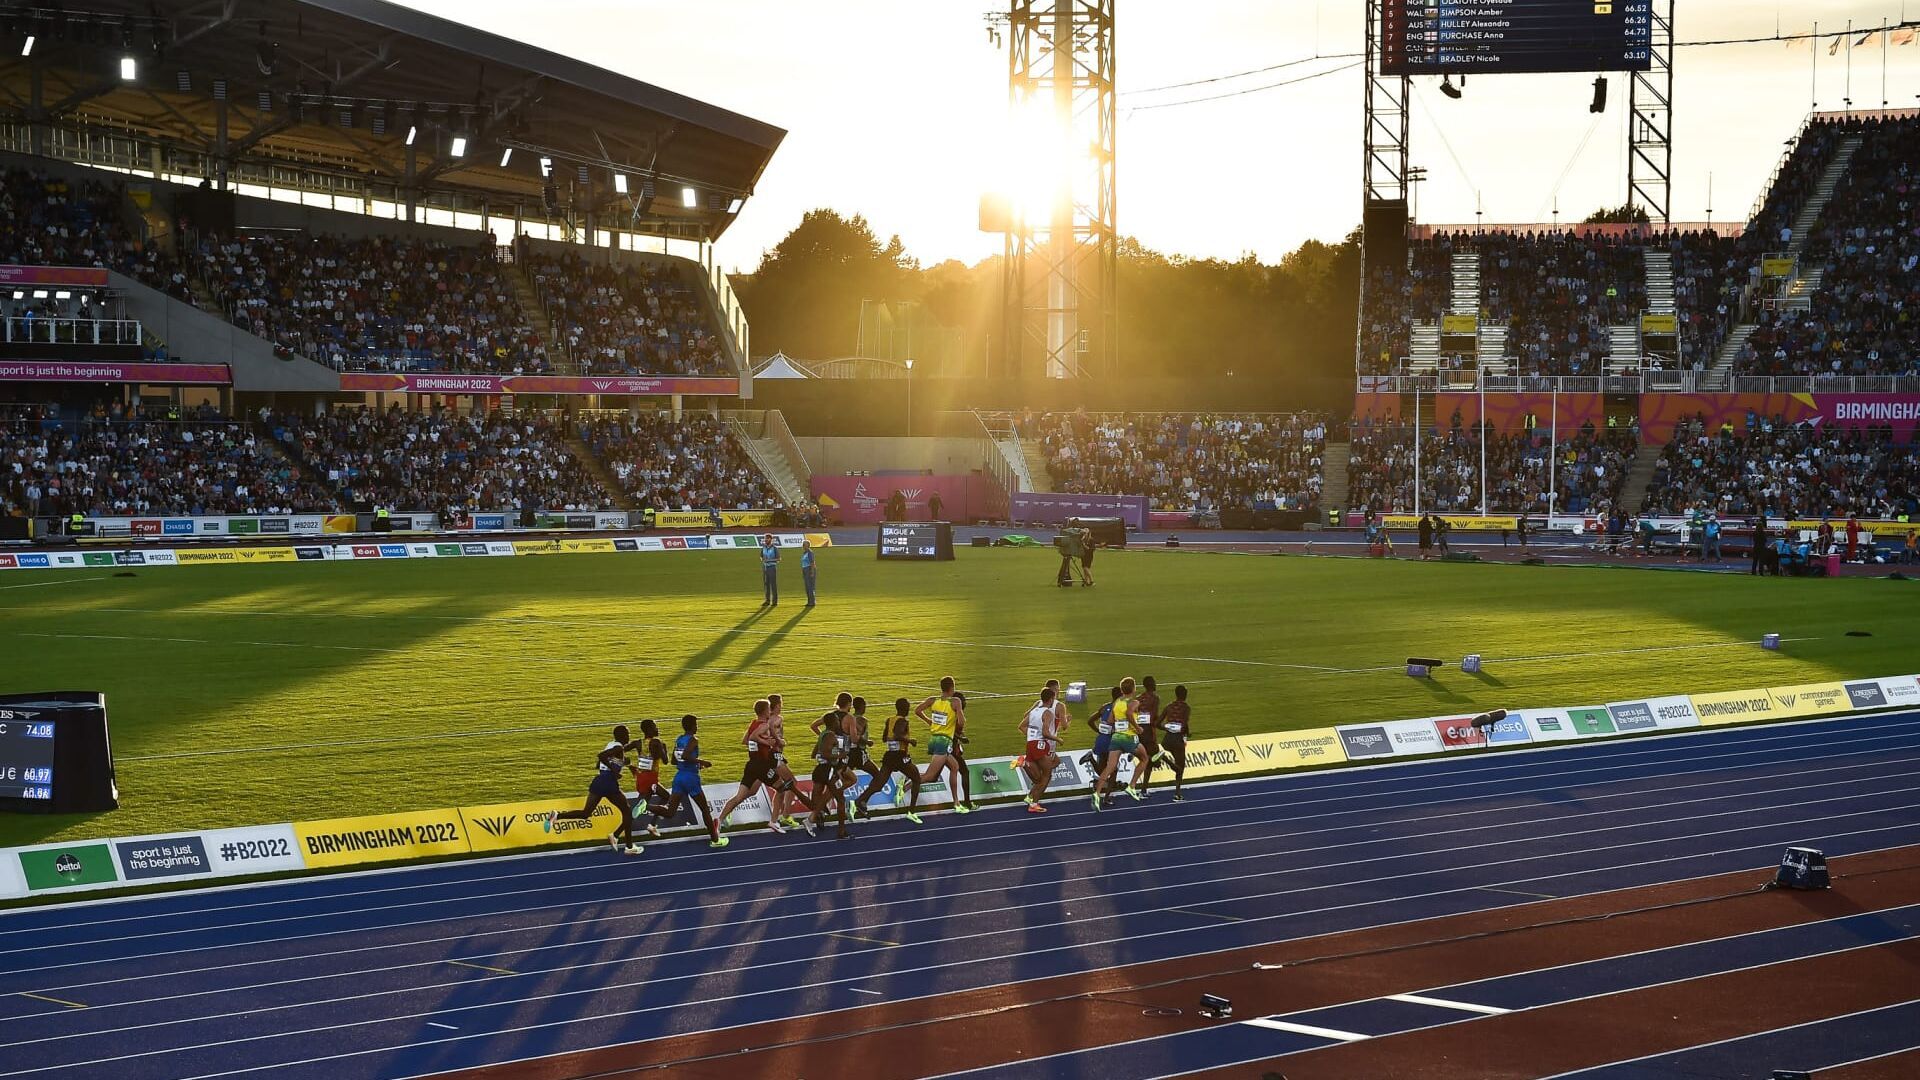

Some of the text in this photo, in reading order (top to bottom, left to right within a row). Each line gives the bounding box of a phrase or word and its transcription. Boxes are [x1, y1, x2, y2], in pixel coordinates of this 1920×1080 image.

[1406, 9, 1424, 17] WAL
[1441, 8, 1476, 16] SIMPSON
[1624, 4, 1647, 12] 66.52
[1408, 21, 1424, 29] AUS
[1440, 20, 1470, 28] HULLEY
[1470, 20, 1510, 28] Alexandra
[1624, 16, 1647, 24] 66.26
[1388, 33, 1393, 41] 7
[1406, 32, 1424, 40] ENG
[1440, 32, 1482, 40] PURCHASE
[1624, 28, 1646, 36] 64.73
[1407, 56, 1423, 64] NZL
[1440, 55, 1476, 63] BRADLEY
[1476, 54, 1500, 62] Nicole
[1623, 51, 1646, 59] 63.10
[0, 365, 122, 378] sport is just the beginning
[416, 378, 492, 390] BIRMINGHAM 2022
[662, 516, 703, 525] BIRMINGHAM
[883, 528, 908, 536] HAGUE
[883, 537, 898, 545] ENG
[178, 553, 219, 561] BIRMINGHAM
[1657, 704, 1693, 720] #B2022
[1696, 698, 1772, 717] BIRMINGHAM 2022
[26, 724, 52, 736] 74.08
[1278, 736, 1337, 751] commonwealth
[1348, 734, 1384, 744] LONGINES
[1209, 748, 1241, 766] 2022
[1297, 746, 1325, 760] games
[552, 819, 593, 835] games
[305, 822, 460, 855] BIRMINGHAM 2022
[131, 844, 193, 860] sport is just
[220, 838, 292, 862] #B2022
[56, 861, 82, 873] Dettol
[129, 854, 201, 870] the beginning
